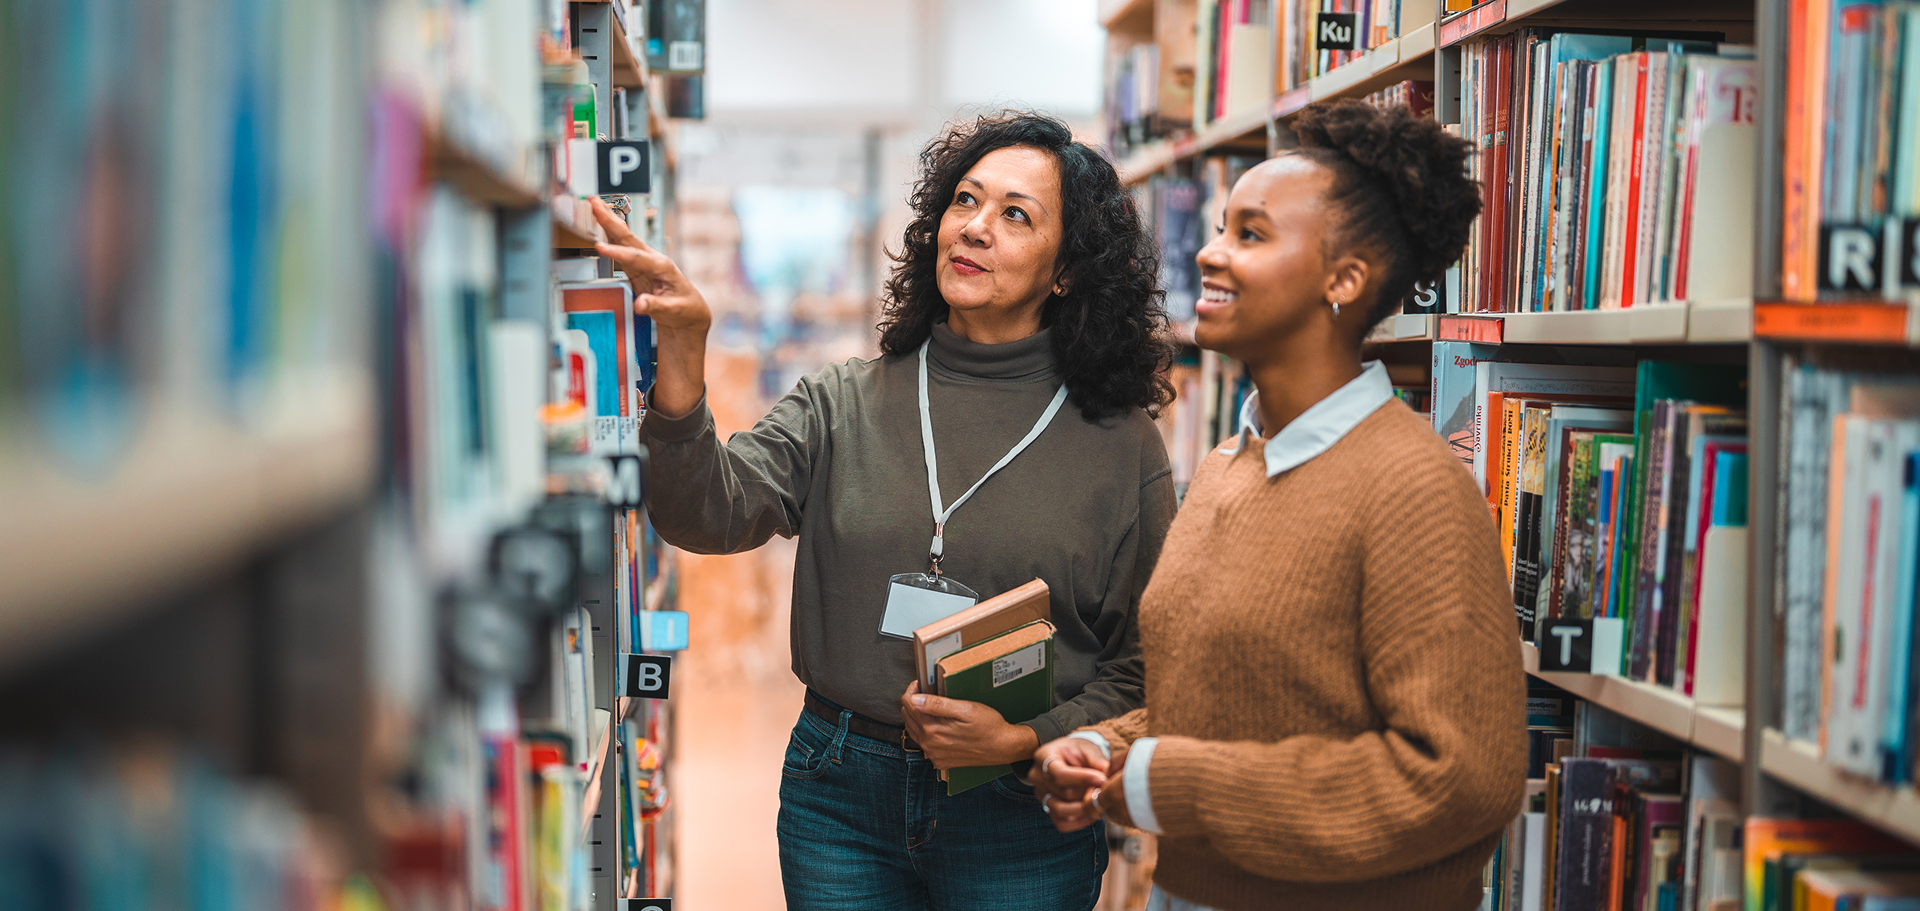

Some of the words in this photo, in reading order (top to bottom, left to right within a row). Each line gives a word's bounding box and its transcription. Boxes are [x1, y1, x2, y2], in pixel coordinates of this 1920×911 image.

[1320, 21, 1351, 43] Ku
[609, 146, 641, 187] P
[1828, 228, 1877, 291] R
[1414, 280, 1437, 307] S
[1550, 625, 1583, 667] T
[638, 662, 663, 692] B
